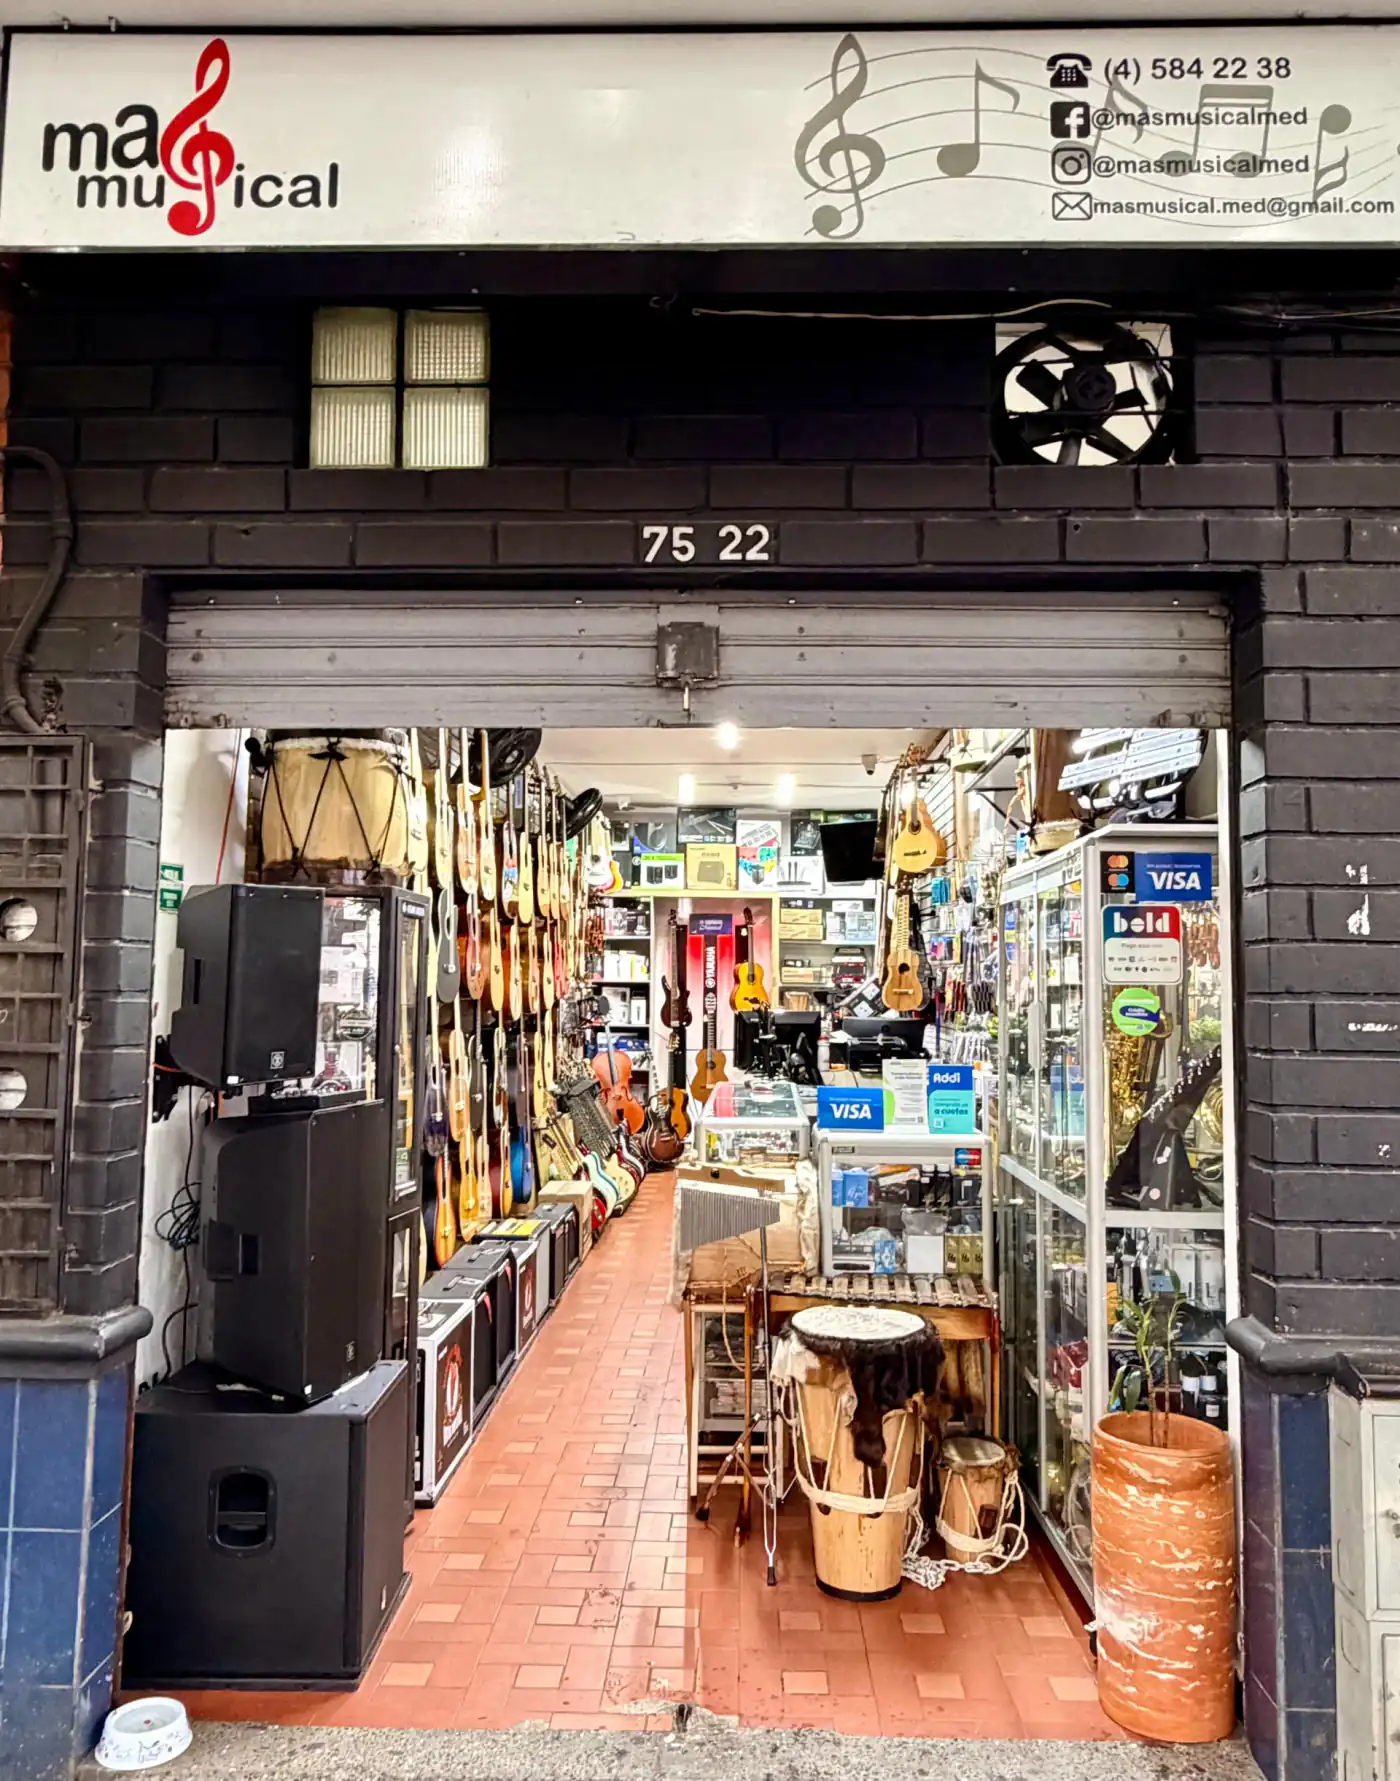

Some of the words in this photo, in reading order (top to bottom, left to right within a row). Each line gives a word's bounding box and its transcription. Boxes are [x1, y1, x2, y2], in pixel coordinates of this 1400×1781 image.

[1104, 57, 1141, 86] (4)
[1151, 57, 1204, 80] 584
[1212, 57, 1248, 80] 22
[1256, 57, 1292, 79] 38
[1092, 106, 1309, 131] @masmusicalmed
[1092, 155, 1310, 178] @masmusicalmed
[1093, 197, 1396, 218] masmusical.med@gmail.com
[642, 525, 696, 563] 75
[718, 523, 770, 561] 22
[1146, 871, 1202, 890] VISA
[1113, 911, 1171, 933] bold
[933, 1072, 961, 1084] Addi
[829, 1103, 872, 1119] VISA
